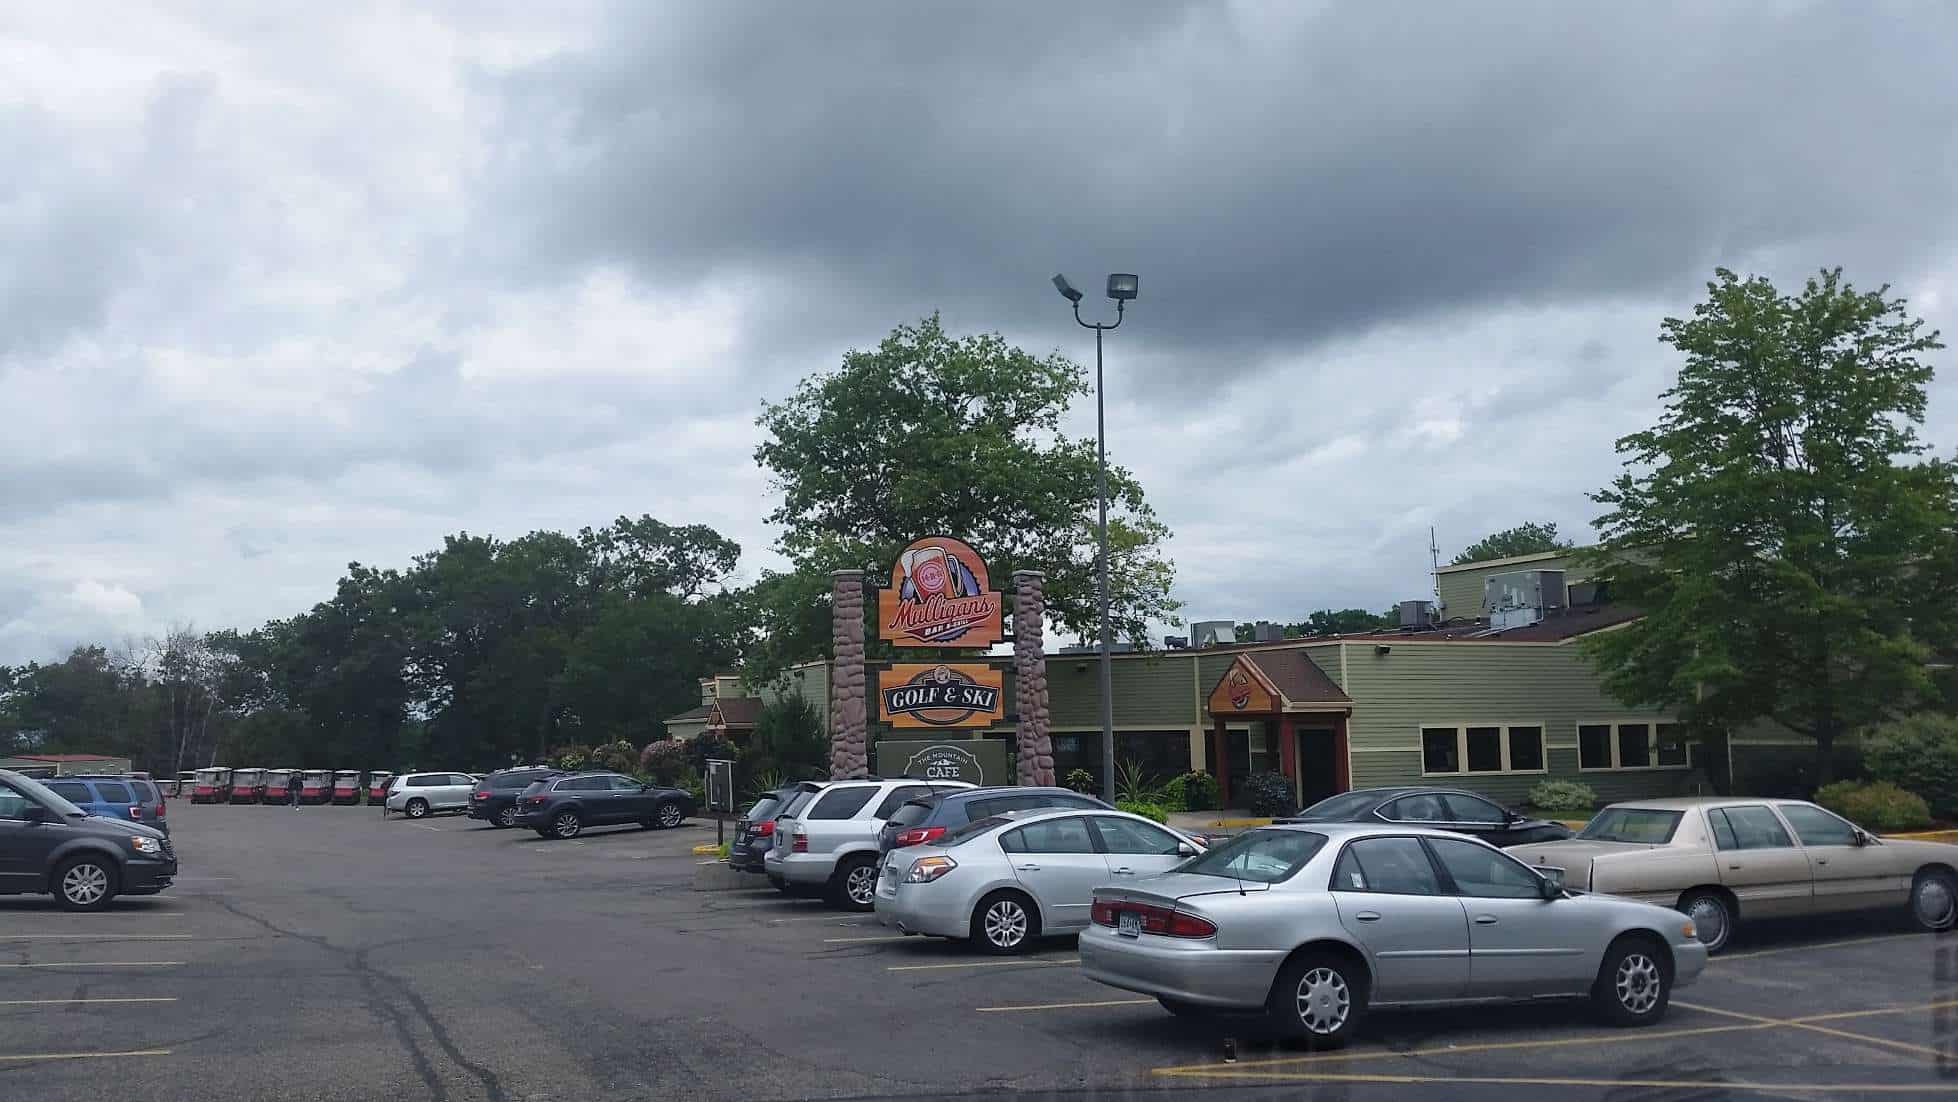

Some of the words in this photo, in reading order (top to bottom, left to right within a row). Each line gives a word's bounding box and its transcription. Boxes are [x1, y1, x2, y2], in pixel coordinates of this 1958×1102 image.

[888, 593, 994, 630] Mulligans
[892, 687, 940, 708] GOLF
[944, 687, 956, 703] &
[962, 688, 993, 707] SKI
[918, 755, 930, 765] THE
[932, 751, 968, 765] MOUNTAIN
[926, 766, 960, 778] CAFE
